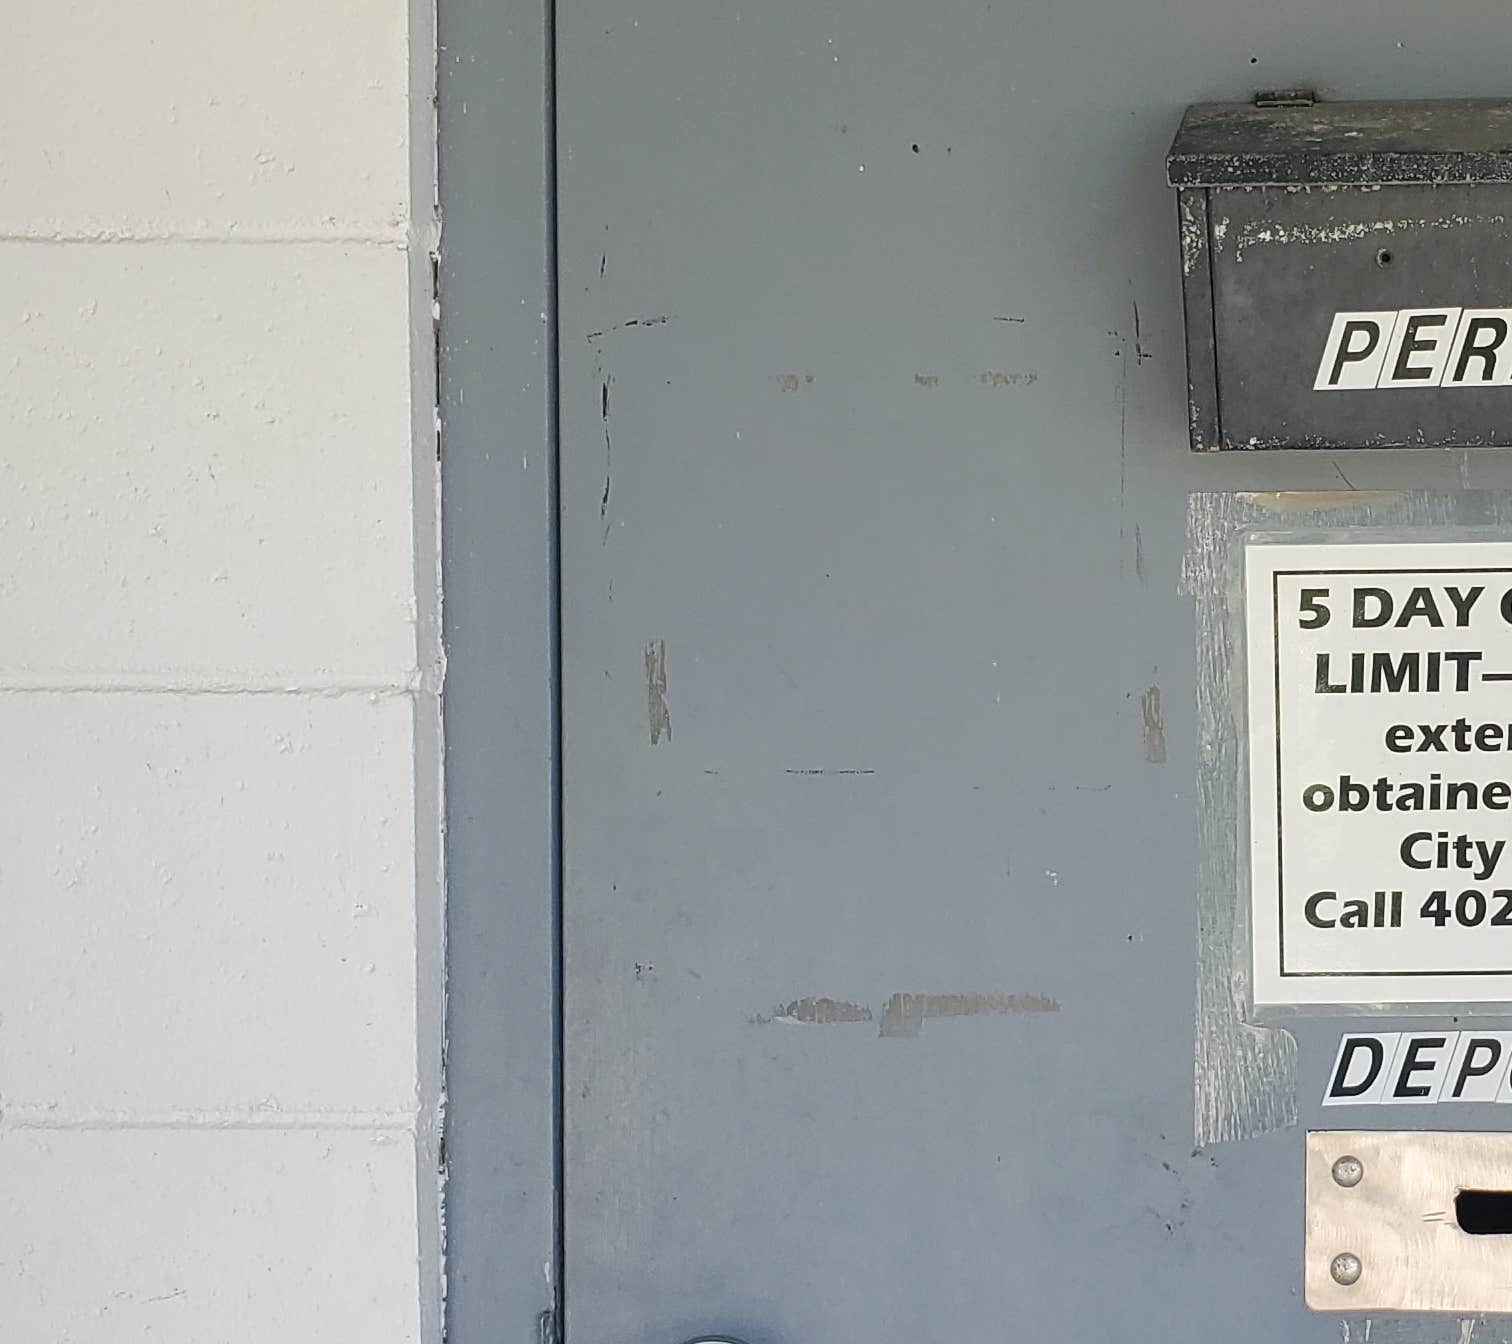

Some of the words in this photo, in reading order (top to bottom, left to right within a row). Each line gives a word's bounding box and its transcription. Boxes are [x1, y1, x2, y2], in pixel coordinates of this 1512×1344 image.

[1299, 589, 1330, 629] 5
[1353, 587, 1485, 628] DAY
[1400, 832, 1506, 880] City
[1305, 892, 1402, 928] Call
